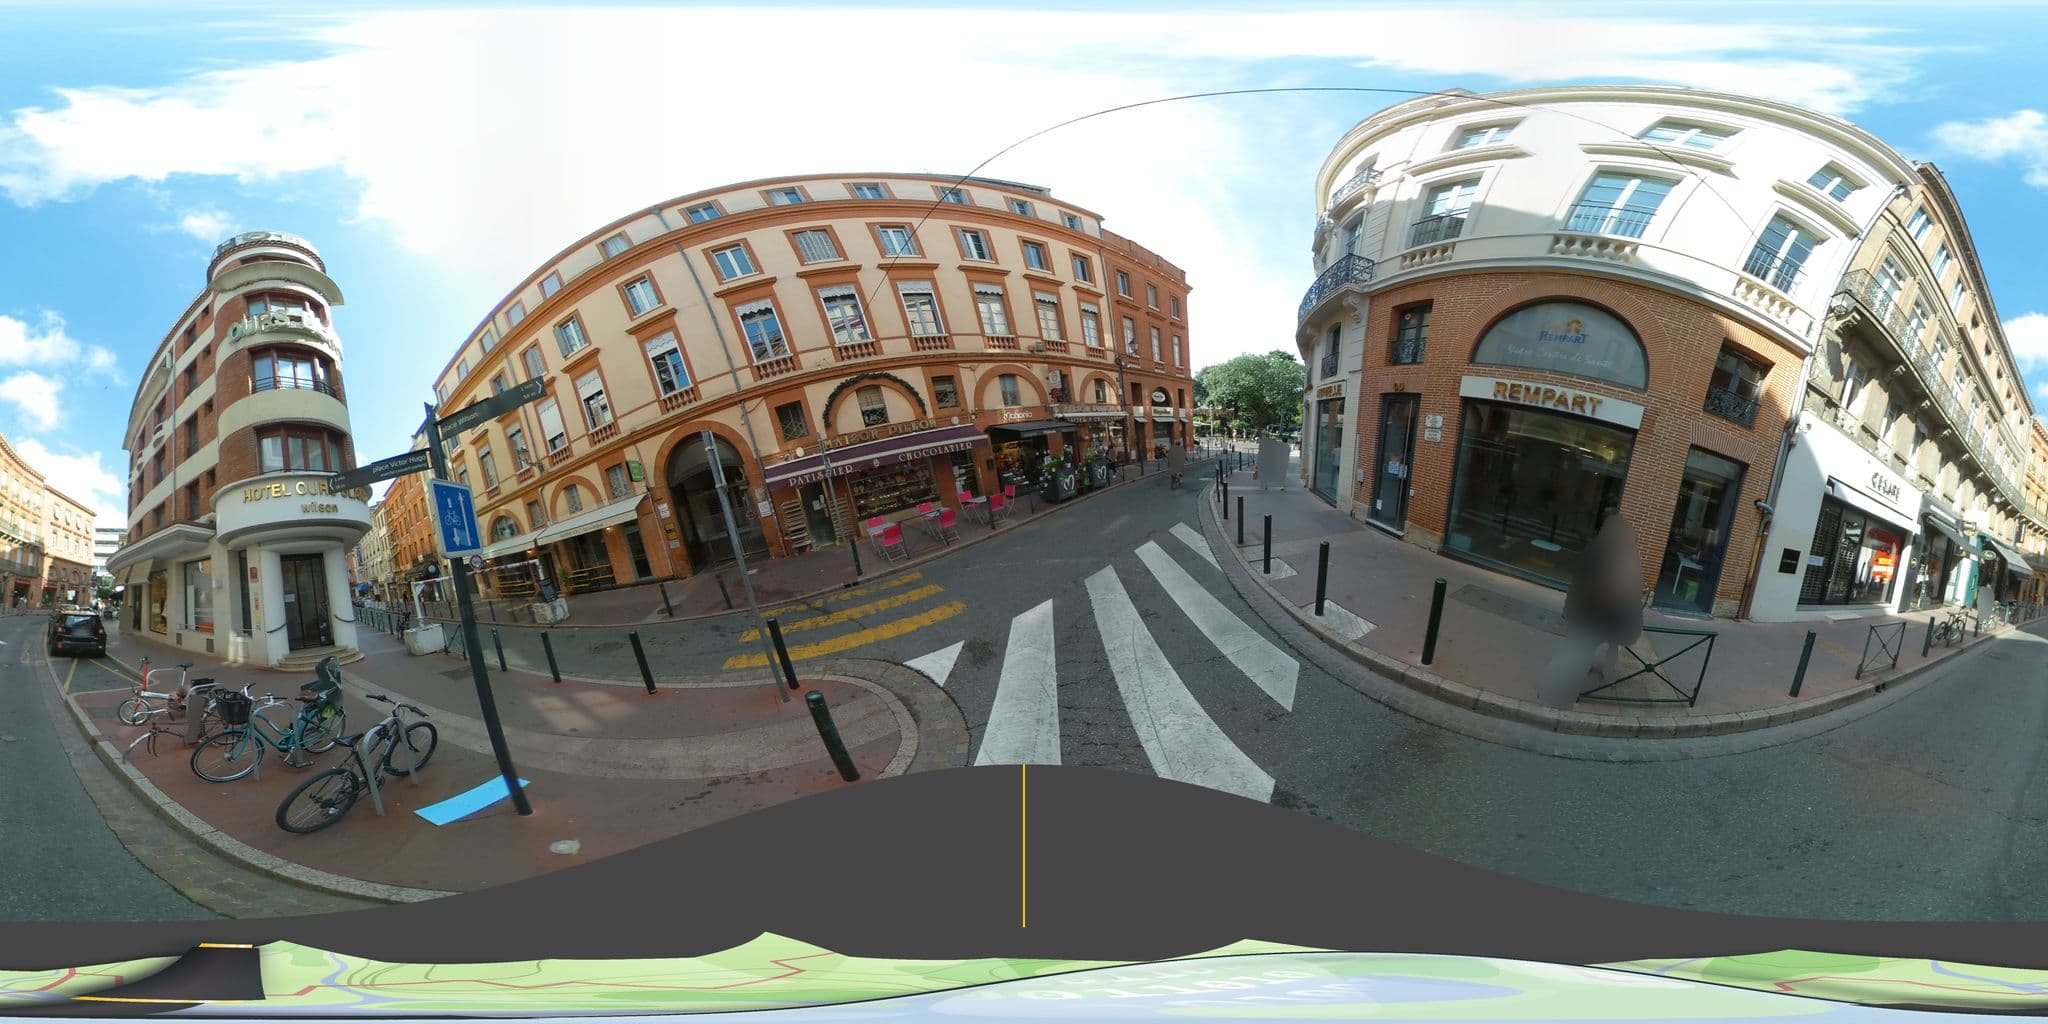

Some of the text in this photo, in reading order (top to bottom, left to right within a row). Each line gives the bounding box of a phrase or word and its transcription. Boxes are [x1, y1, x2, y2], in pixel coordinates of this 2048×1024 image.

[1538, 329, 1589, 344] REMPART
[1494, 381, 1603, 416] REMPART
[824, 429, 879, 449] MAISON
[372, 454, 426, 474] place Victor Hugo
[789, 441, 973, 486] PATISIER CHOCOLATIER
[243, 483, 292, 503] HOTEL
[296, 481, 337, 496] OUR
[302, 502, 338, 513] wilson
